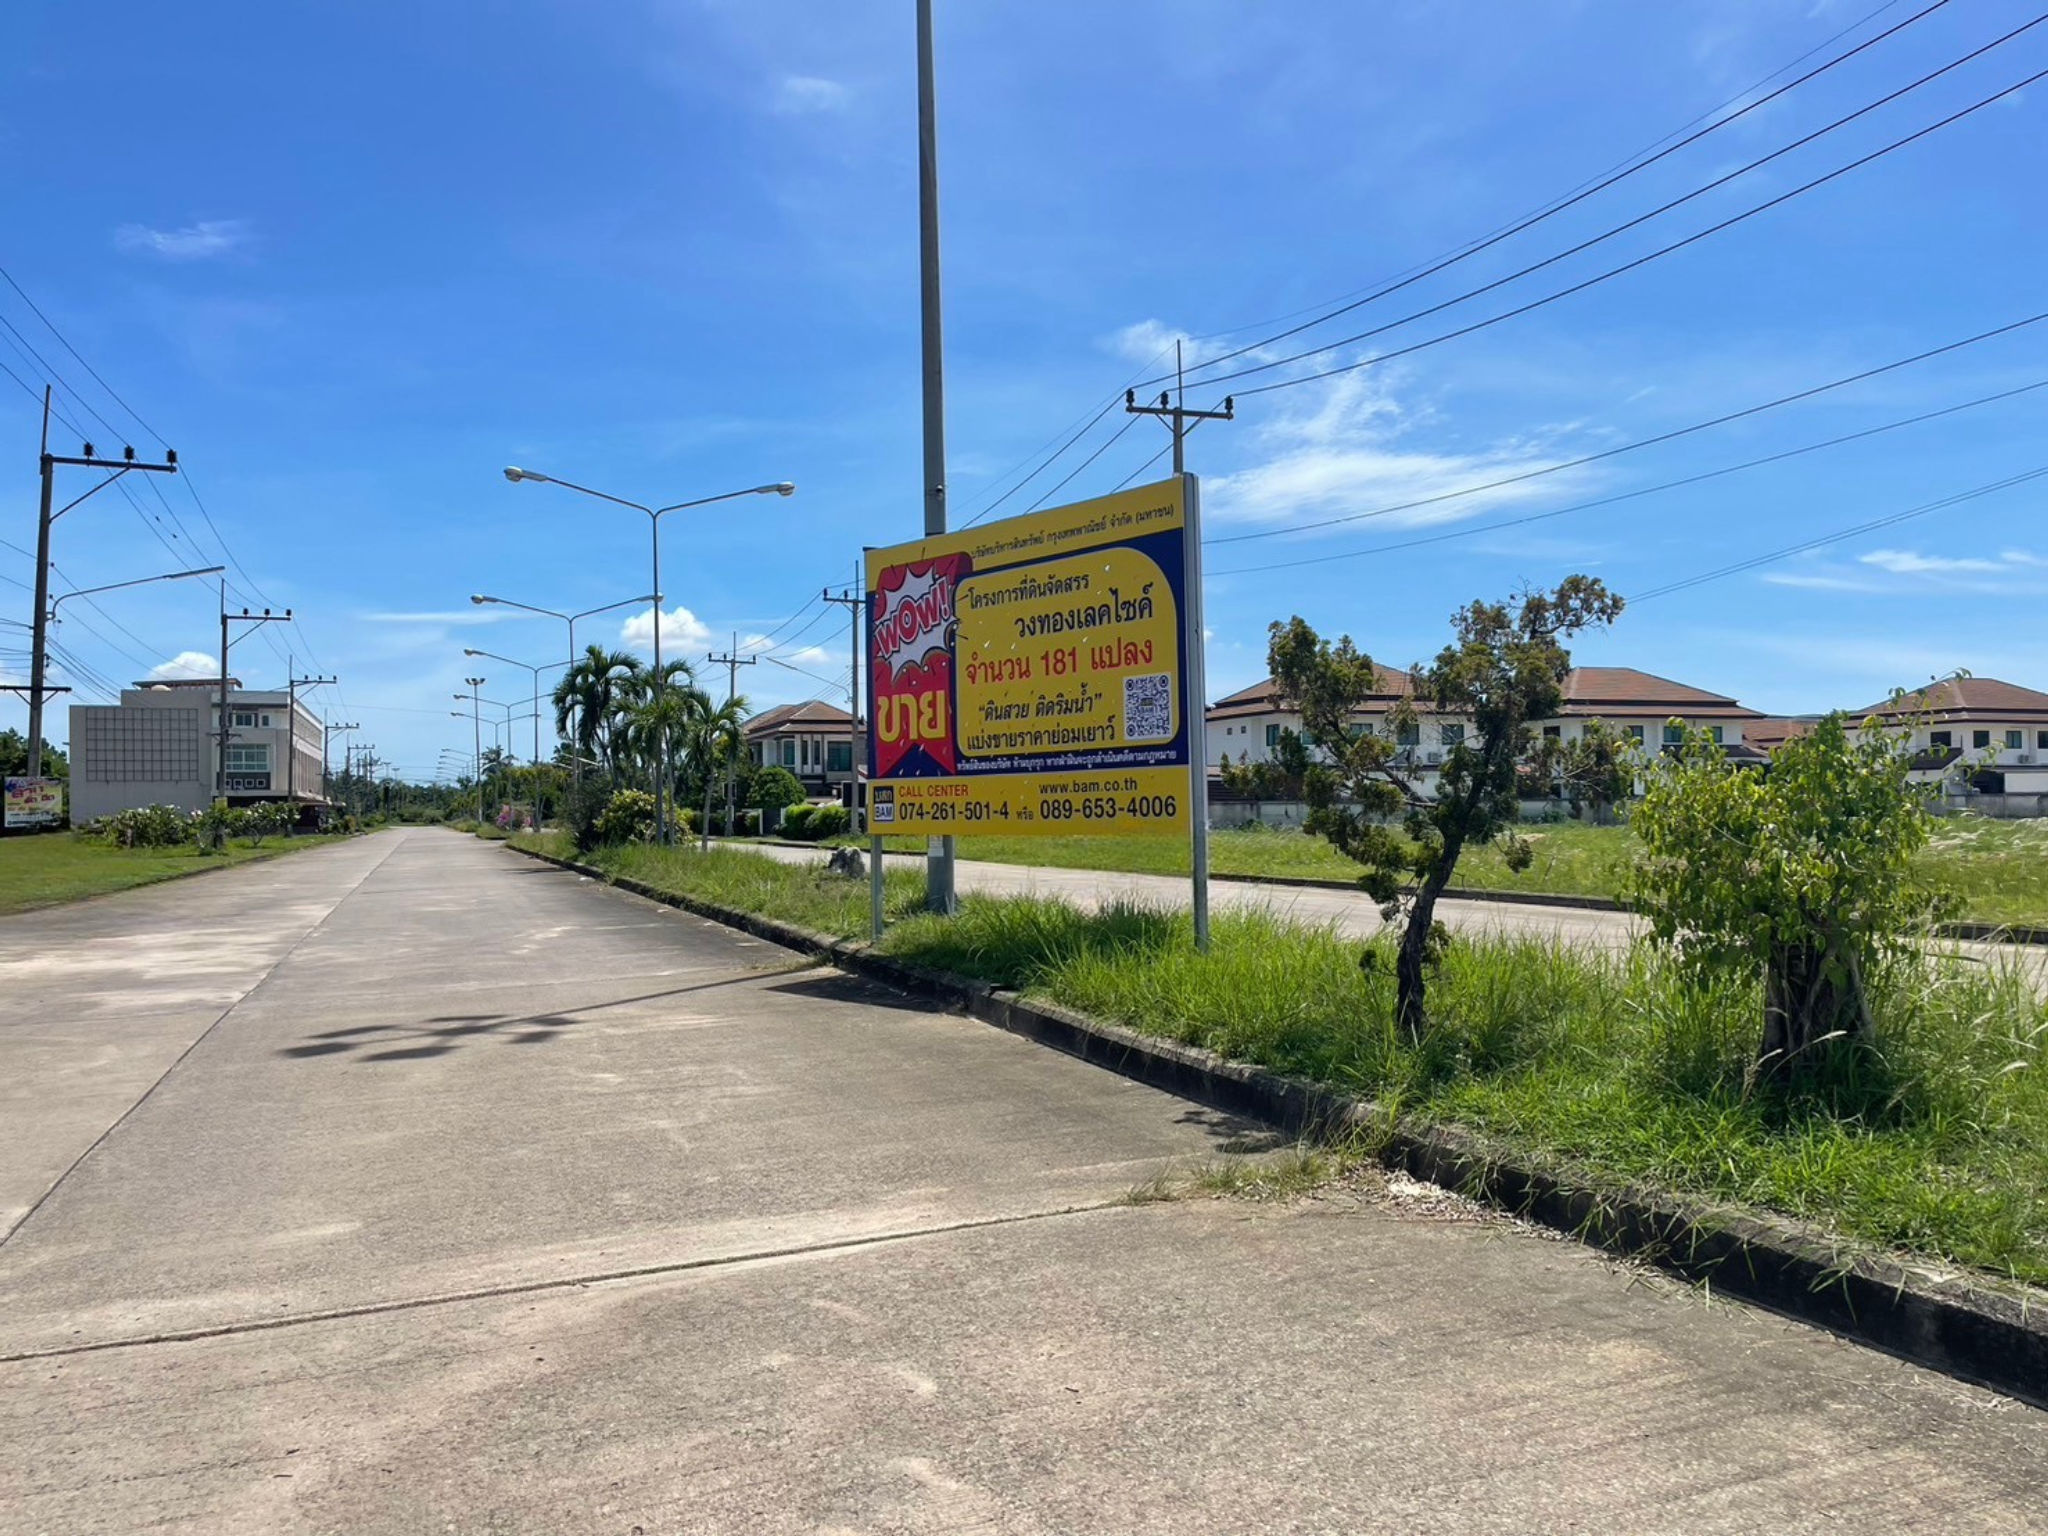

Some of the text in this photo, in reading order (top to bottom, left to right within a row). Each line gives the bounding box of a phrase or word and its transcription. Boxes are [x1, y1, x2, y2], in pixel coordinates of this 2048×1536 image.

[1109, 511, 1133, 529] จำกัด
[1135, 503, 1175, 525] (มหาชน)
[968, 573, 1090, 610] โครงการที่ดินจัดสรร
[876, 577, 951, 656] WOW!
[965, 636, 1153, 685] จำนวน 181 แปลง
[878, 689, 946, 743] ขาย
[899, 784, 969, 798] CALL CENTER
[1038, 777, 1138, 795] www.bam.co.th
[875, 806, 893, 818] BAM
[899, 801, 1009, 821] 074-261-501-4
[1039, 795, 1177, 820] 089-653-4006
